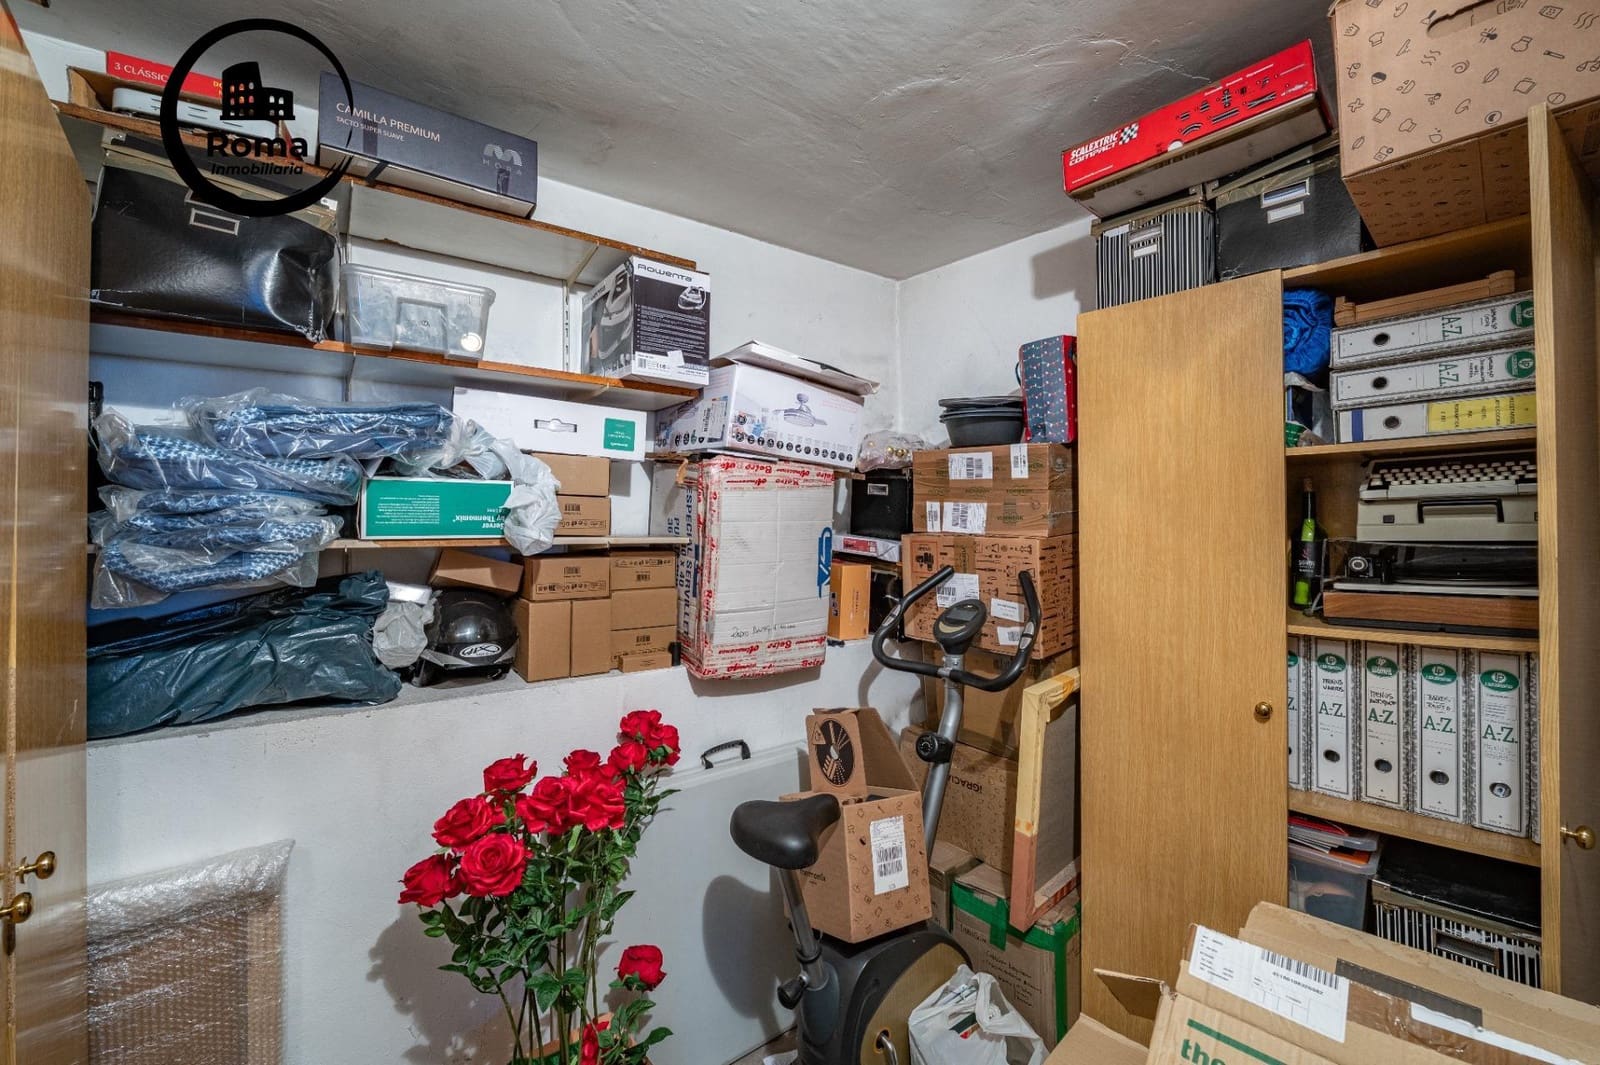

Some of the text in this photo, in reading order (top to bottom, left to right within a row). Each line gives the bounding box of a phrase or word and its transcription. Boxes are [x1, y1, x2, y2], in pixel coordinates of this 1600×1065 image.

[114, 62, 169, 83] 3 CLÁSSIC
[336, 102, 440, 142] CAMILLA PREMIUM
[1070, 130, 1120, 160] SCALEXTRIC
[683, 560, 693, 636] SERVILLET
